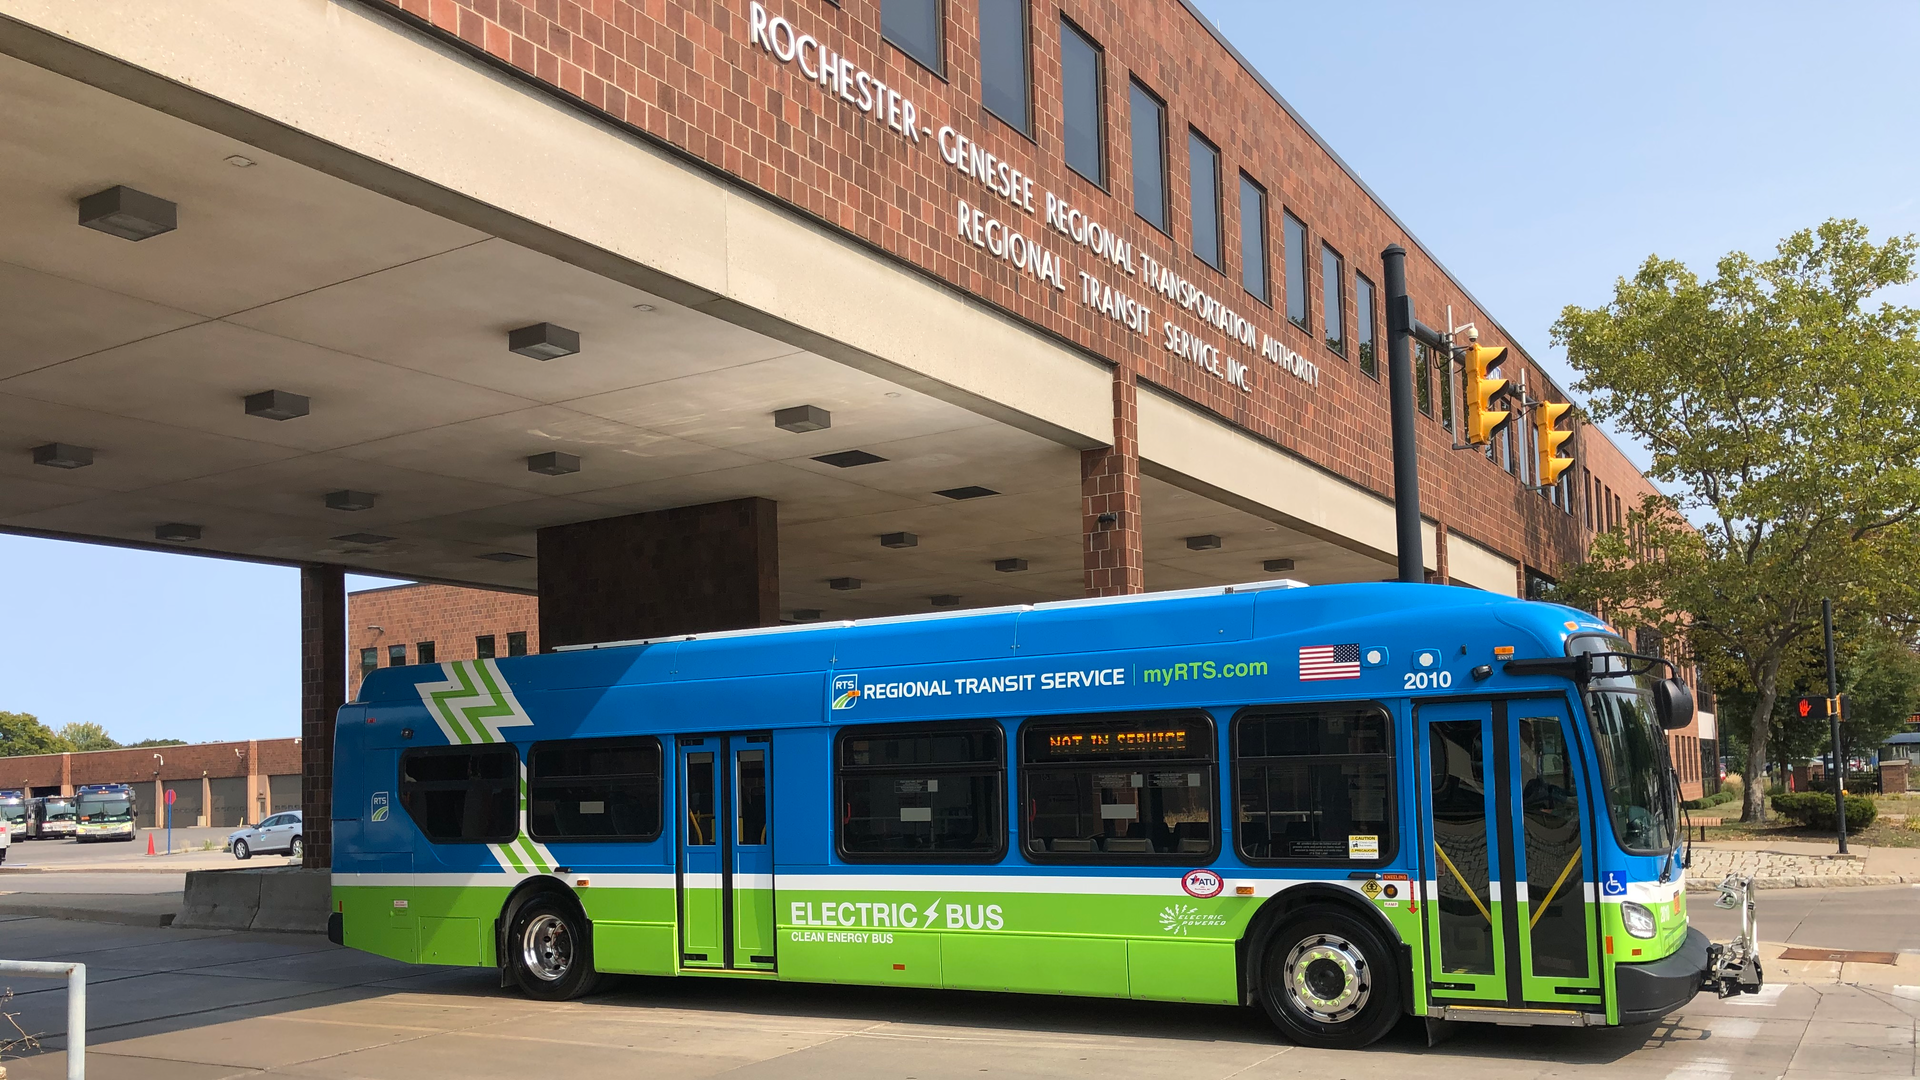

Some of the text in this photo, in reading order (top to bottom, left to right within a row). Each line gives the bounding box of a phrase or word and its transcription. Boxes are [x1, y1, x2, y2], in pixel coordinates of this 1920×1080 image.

[750, 2, 919, 143] ROCHESTER
[938, 126, 1034, 213] GENESEE
[1046, 192, 1135, 275] REGIONAL
[1140, 252, 1256, 349] TRANSPORTATION
[1262, 334, 1319, 388] AUTHORITY
[958, 200, 1253, 393] REGIONAL TRANSIT SERVICE, INC.
[835, 680, 855, 690] RTS
[864, 668, 1125, 699] REGIONAL TRANSIT SERVICE
[1143, 660, 1268, 687] myRTS.com
[1403, 670, 1452, 690] 2010
[1090, 734, 1110, 751] IN
[1198, 878, 1216, 886] ATU
[790, 902, 1004, 930] ELECTRIC BUS
[791, 932, 894, 944] CLEAN ENERGY BUS
